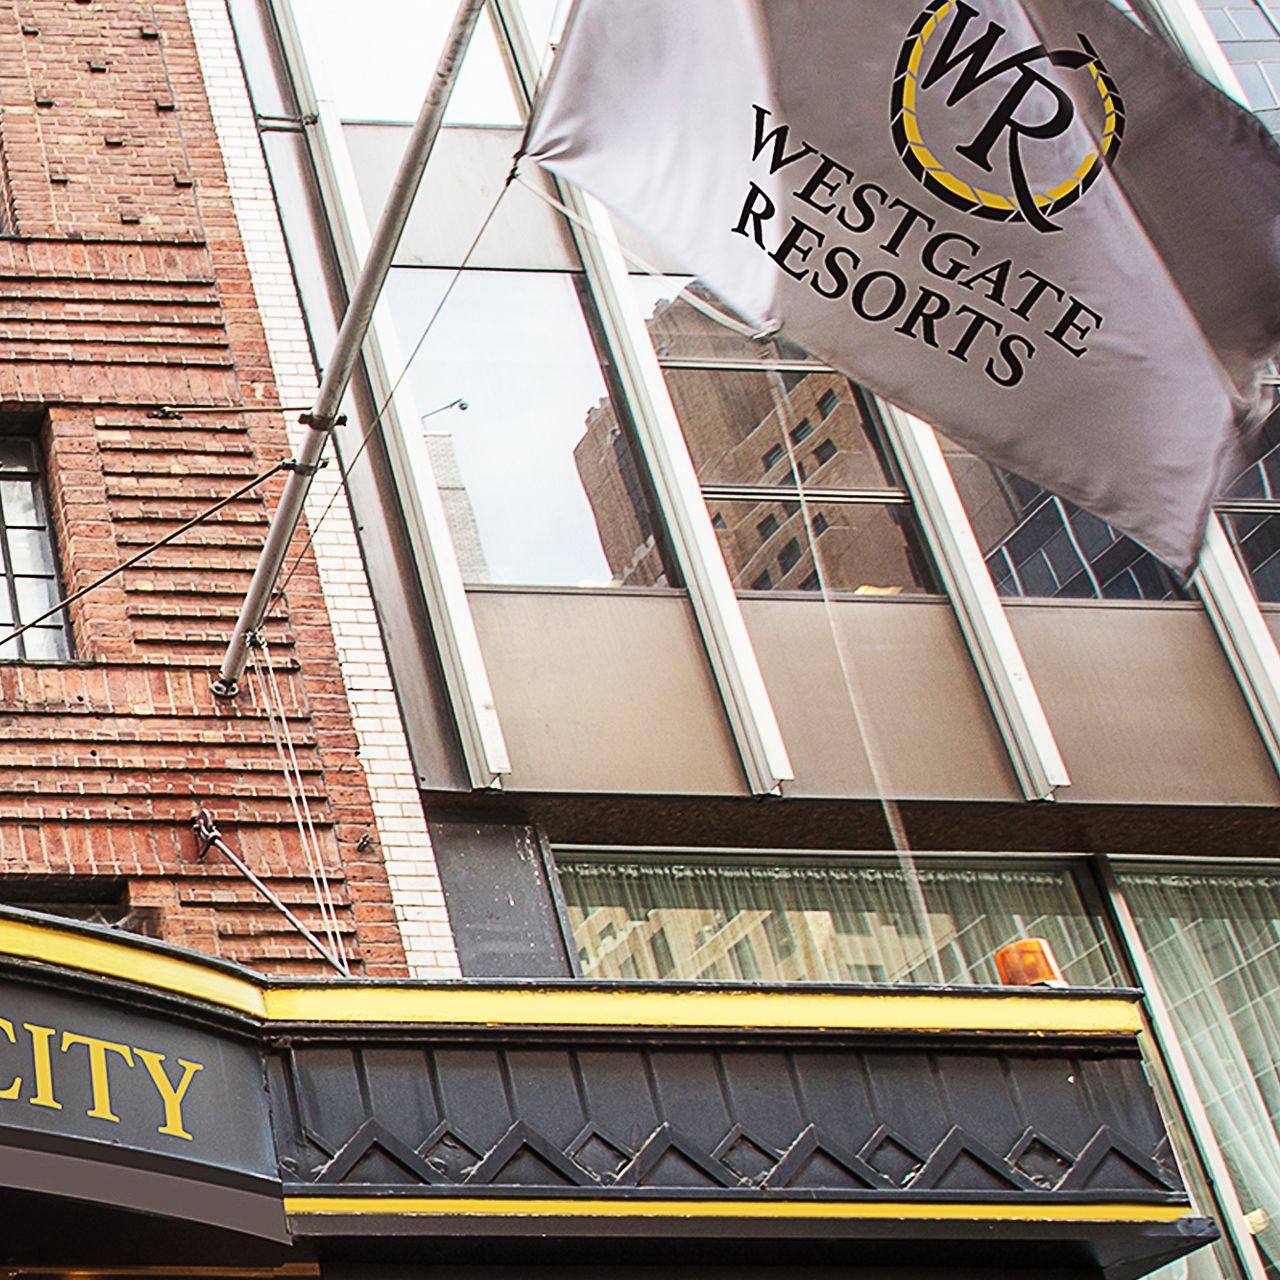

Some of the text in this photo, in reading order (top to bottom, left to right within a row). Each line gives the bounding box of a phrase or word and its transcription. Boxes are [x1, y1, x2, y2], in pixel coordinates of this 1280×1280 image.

[752, 104, 1103, 358] WESTGATE
[920, 0, 1082, 233] WR
[731, 181, 1036, 388] RESORTS
